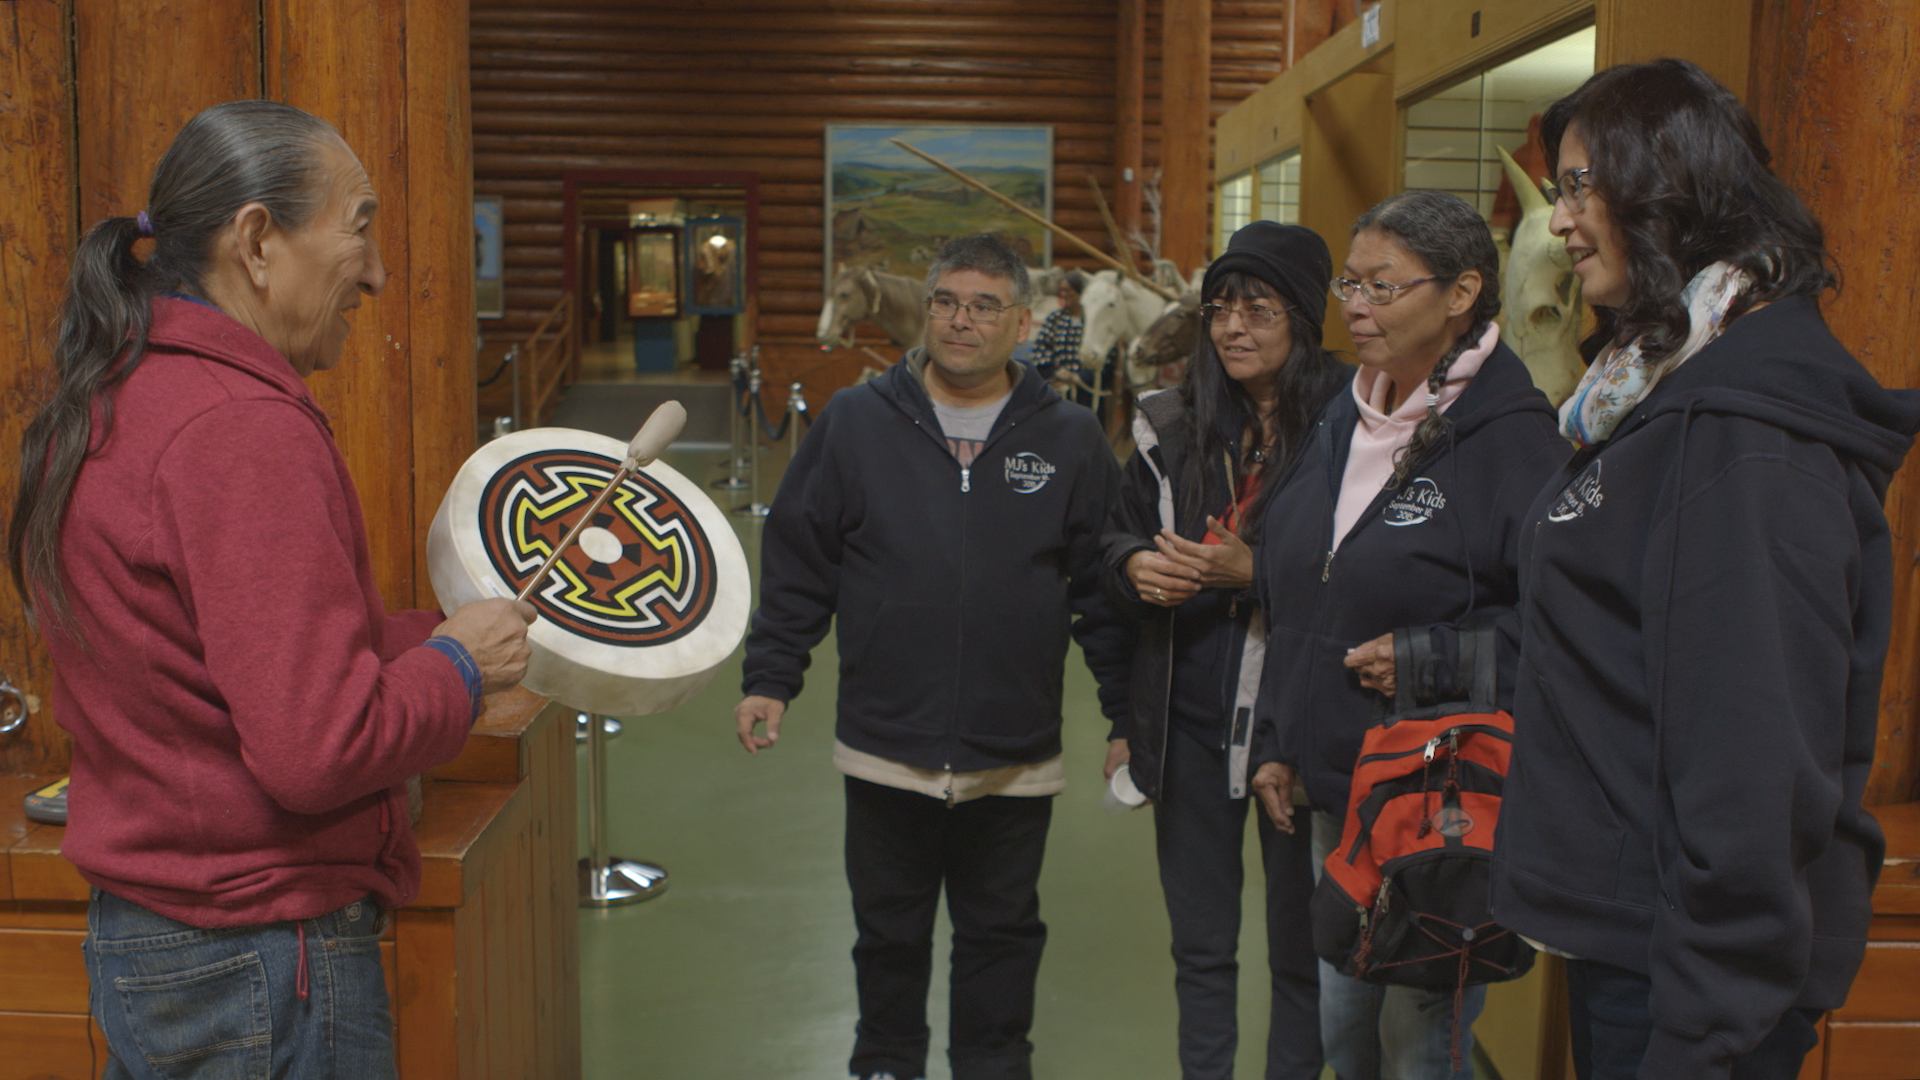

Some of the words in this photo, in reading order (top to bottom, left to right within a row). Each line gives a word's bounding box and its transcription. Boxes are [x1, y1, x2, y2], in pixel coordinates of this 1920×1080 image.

[1004, 456, 1028, 472] MJ's
[1031, 460, 1057, 474] Kids
[1416, 487, 1446, 509] Kids
